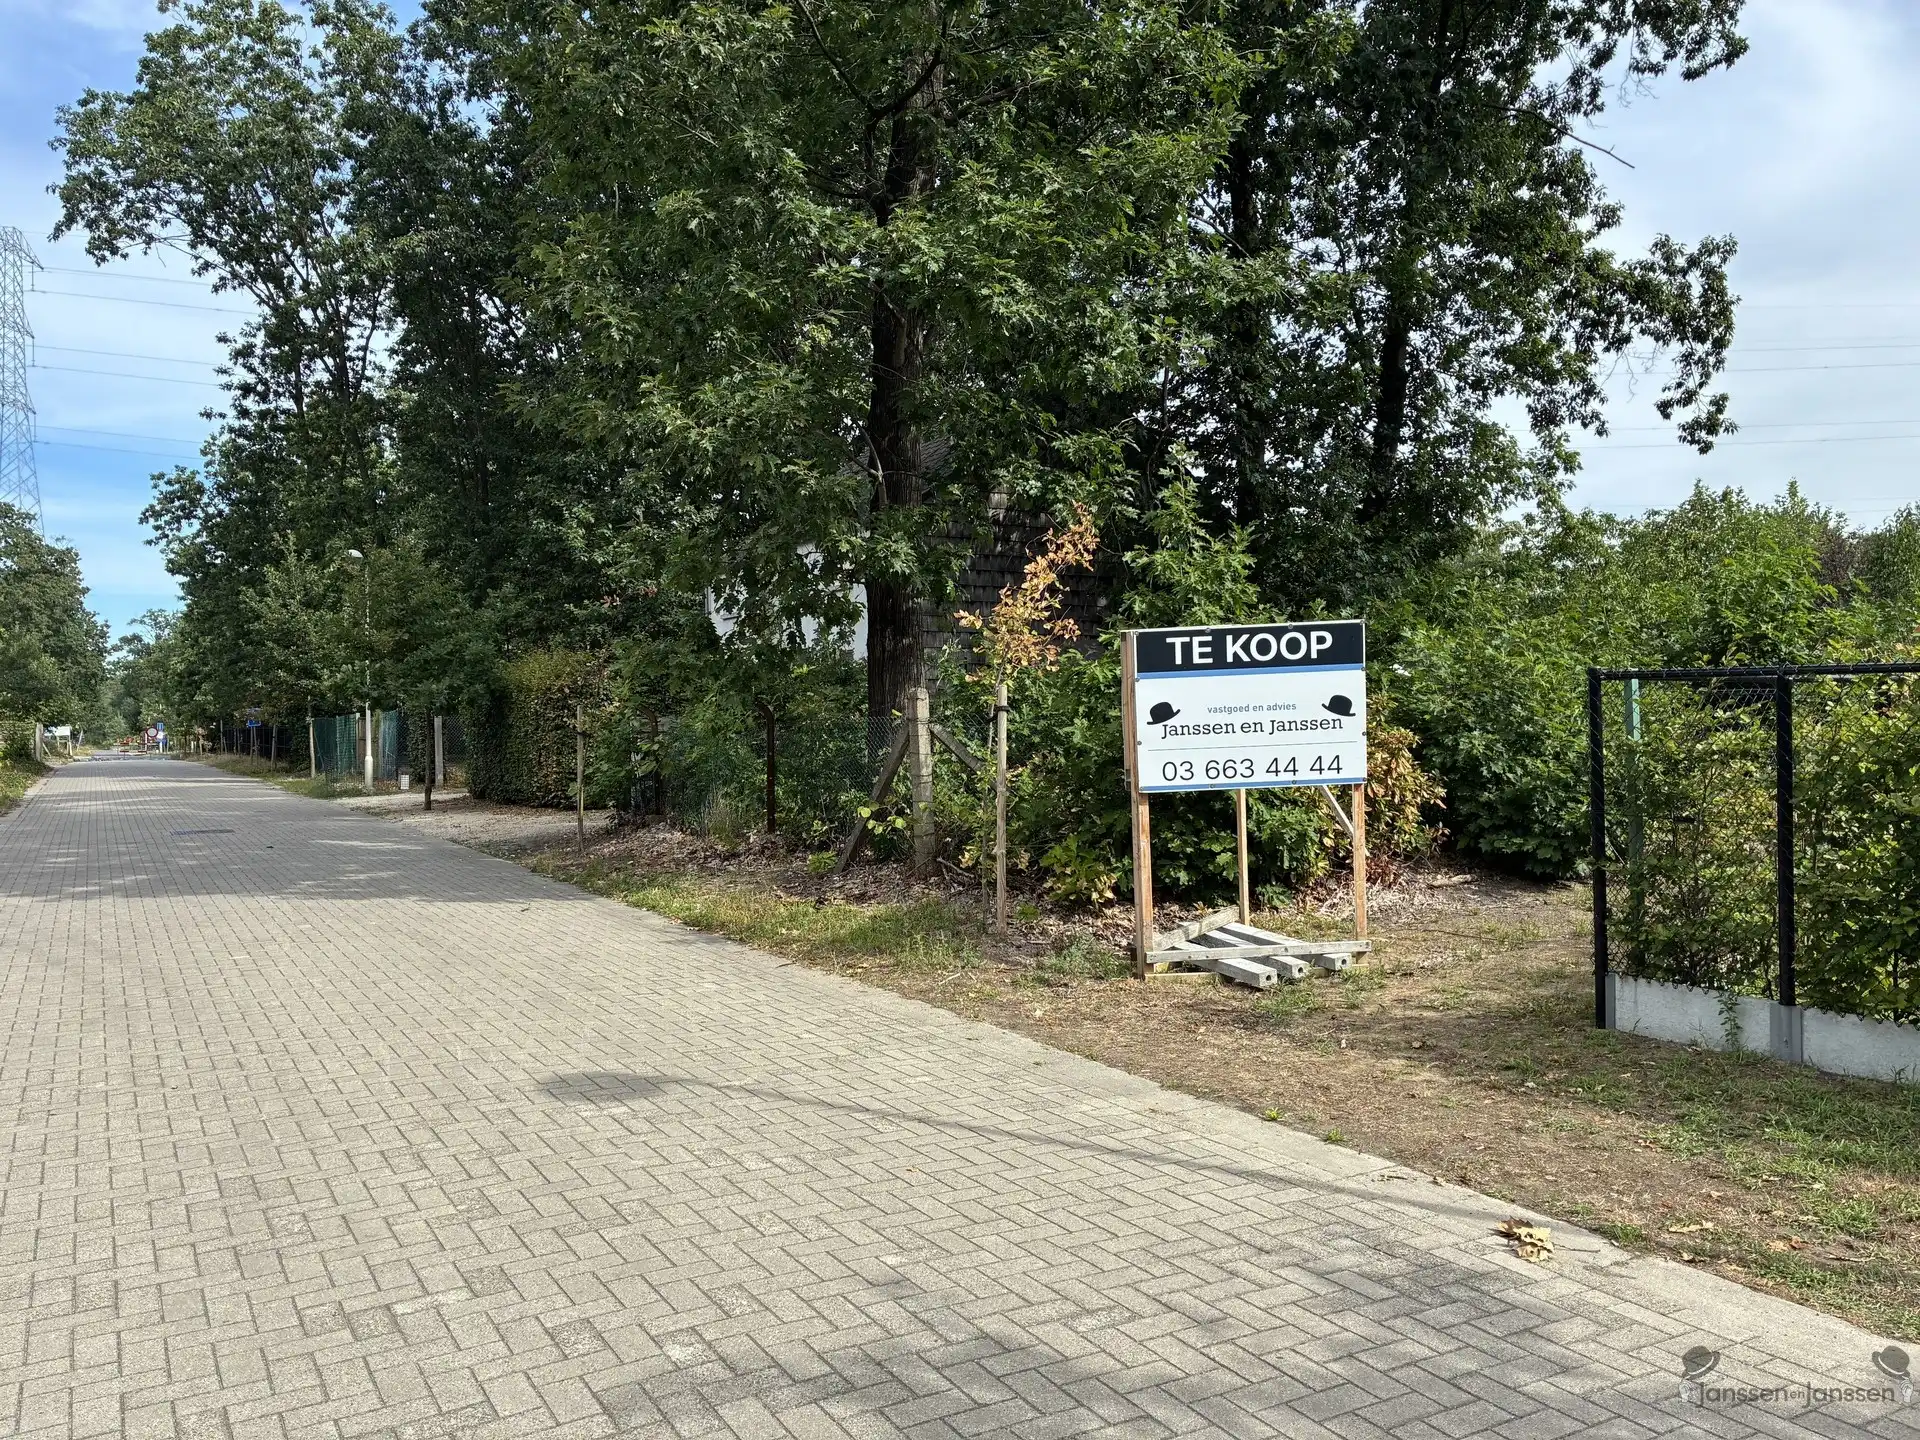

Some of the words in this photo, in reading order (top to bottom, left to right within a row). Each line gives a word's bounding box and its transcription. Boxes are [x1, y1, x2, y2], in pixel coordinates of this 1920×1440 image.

[1166, 636, 1213, 665] TE
[1226, 631, 1333, 663] KOOP
[1207, 703, 1250, 715] vastgoed
[1267, 702, 1296, 711] advies
[1161, 722, 1236, 739] Janssen
[1240, 722, 1264, 733] en
[1269, 718, 1343, 735] Janssen
[1162, 761, 1194, 781] 03
[1205, 759, 1254, 779] 663
[1266, 757, 1299, 777] 44
[1309, 755, 1343, 775] 44
